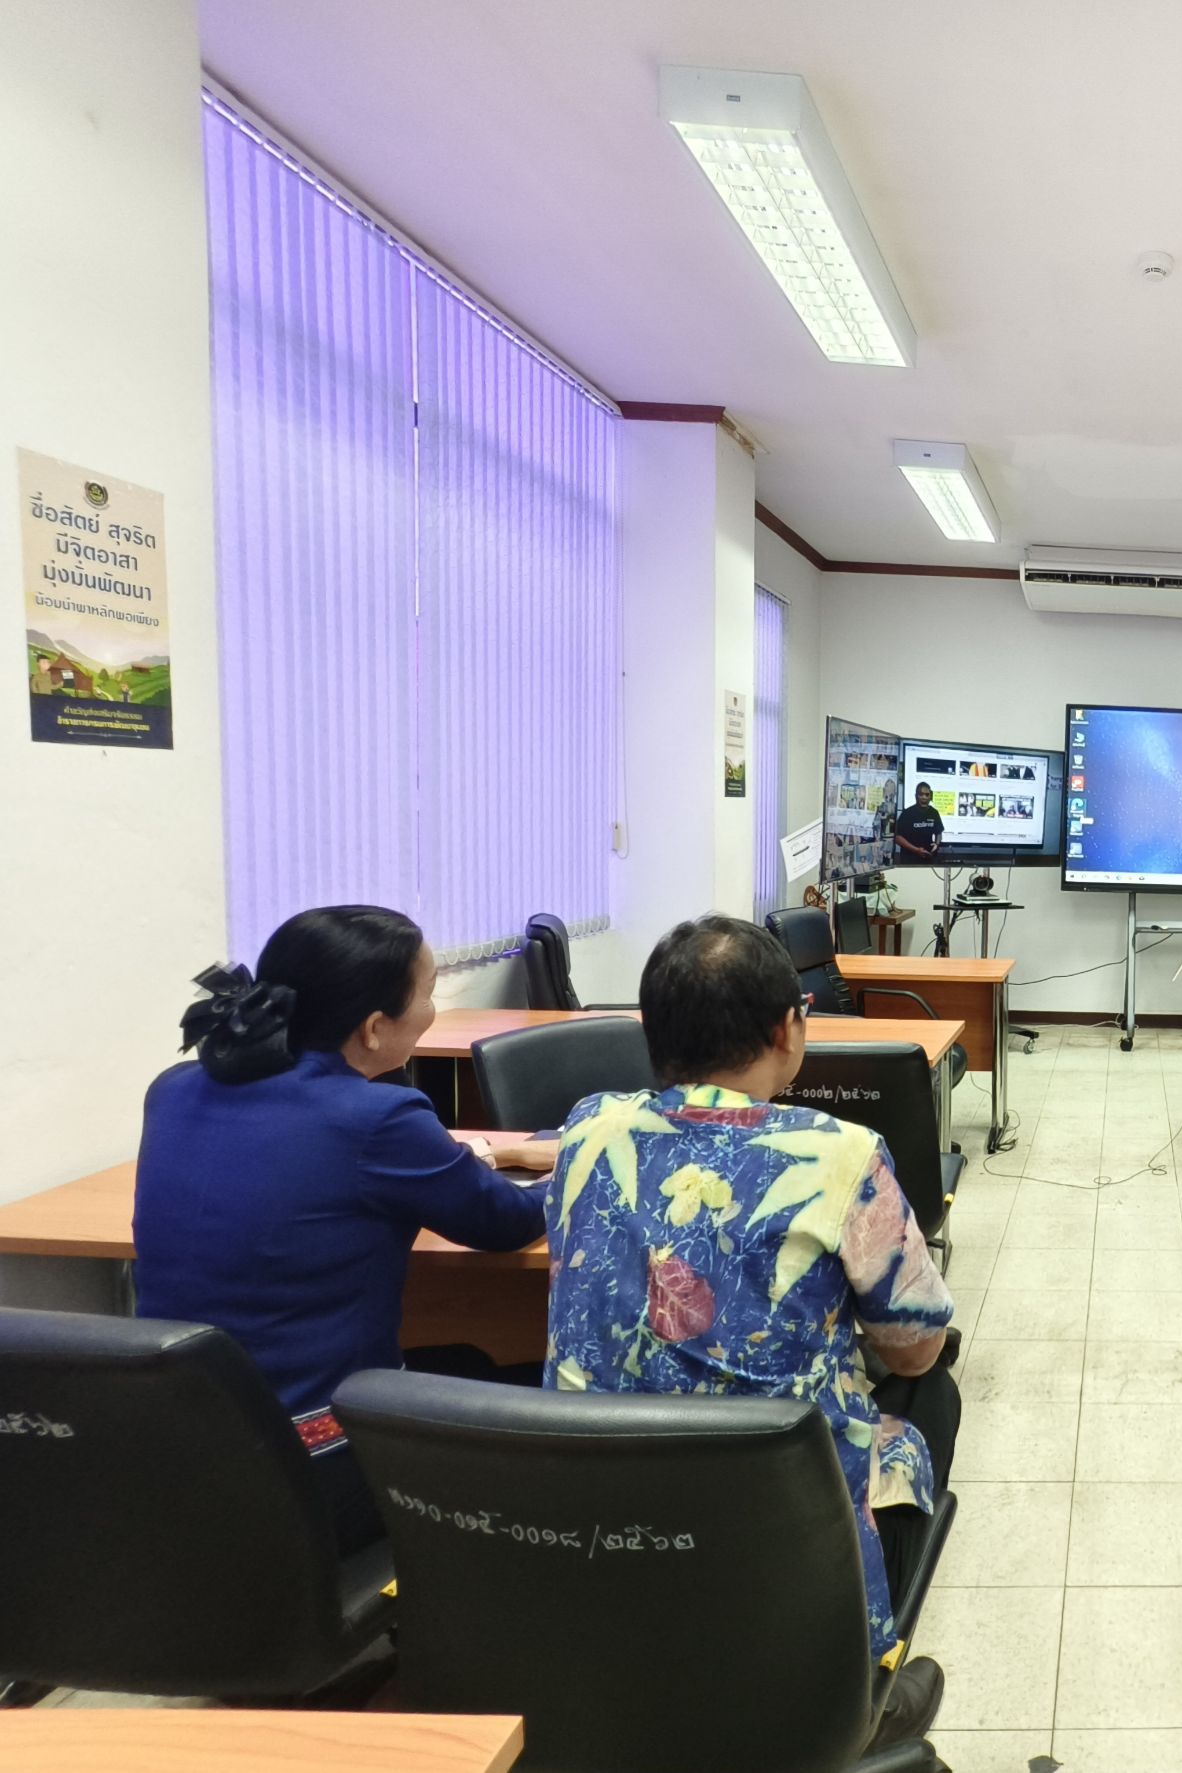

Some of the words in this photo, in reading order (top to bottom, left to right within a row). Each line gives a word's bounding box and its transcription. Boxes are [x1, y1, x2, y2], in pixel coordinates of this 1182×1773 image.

[30, 491, 100, 534] ซื่อสัตย์
[109, 524, 156, 549] สุจริต
[56, 532, 138, 571] มีจิตอาสา
[43, 560, 152, 601] มุ่งมั่นพัฒนา
